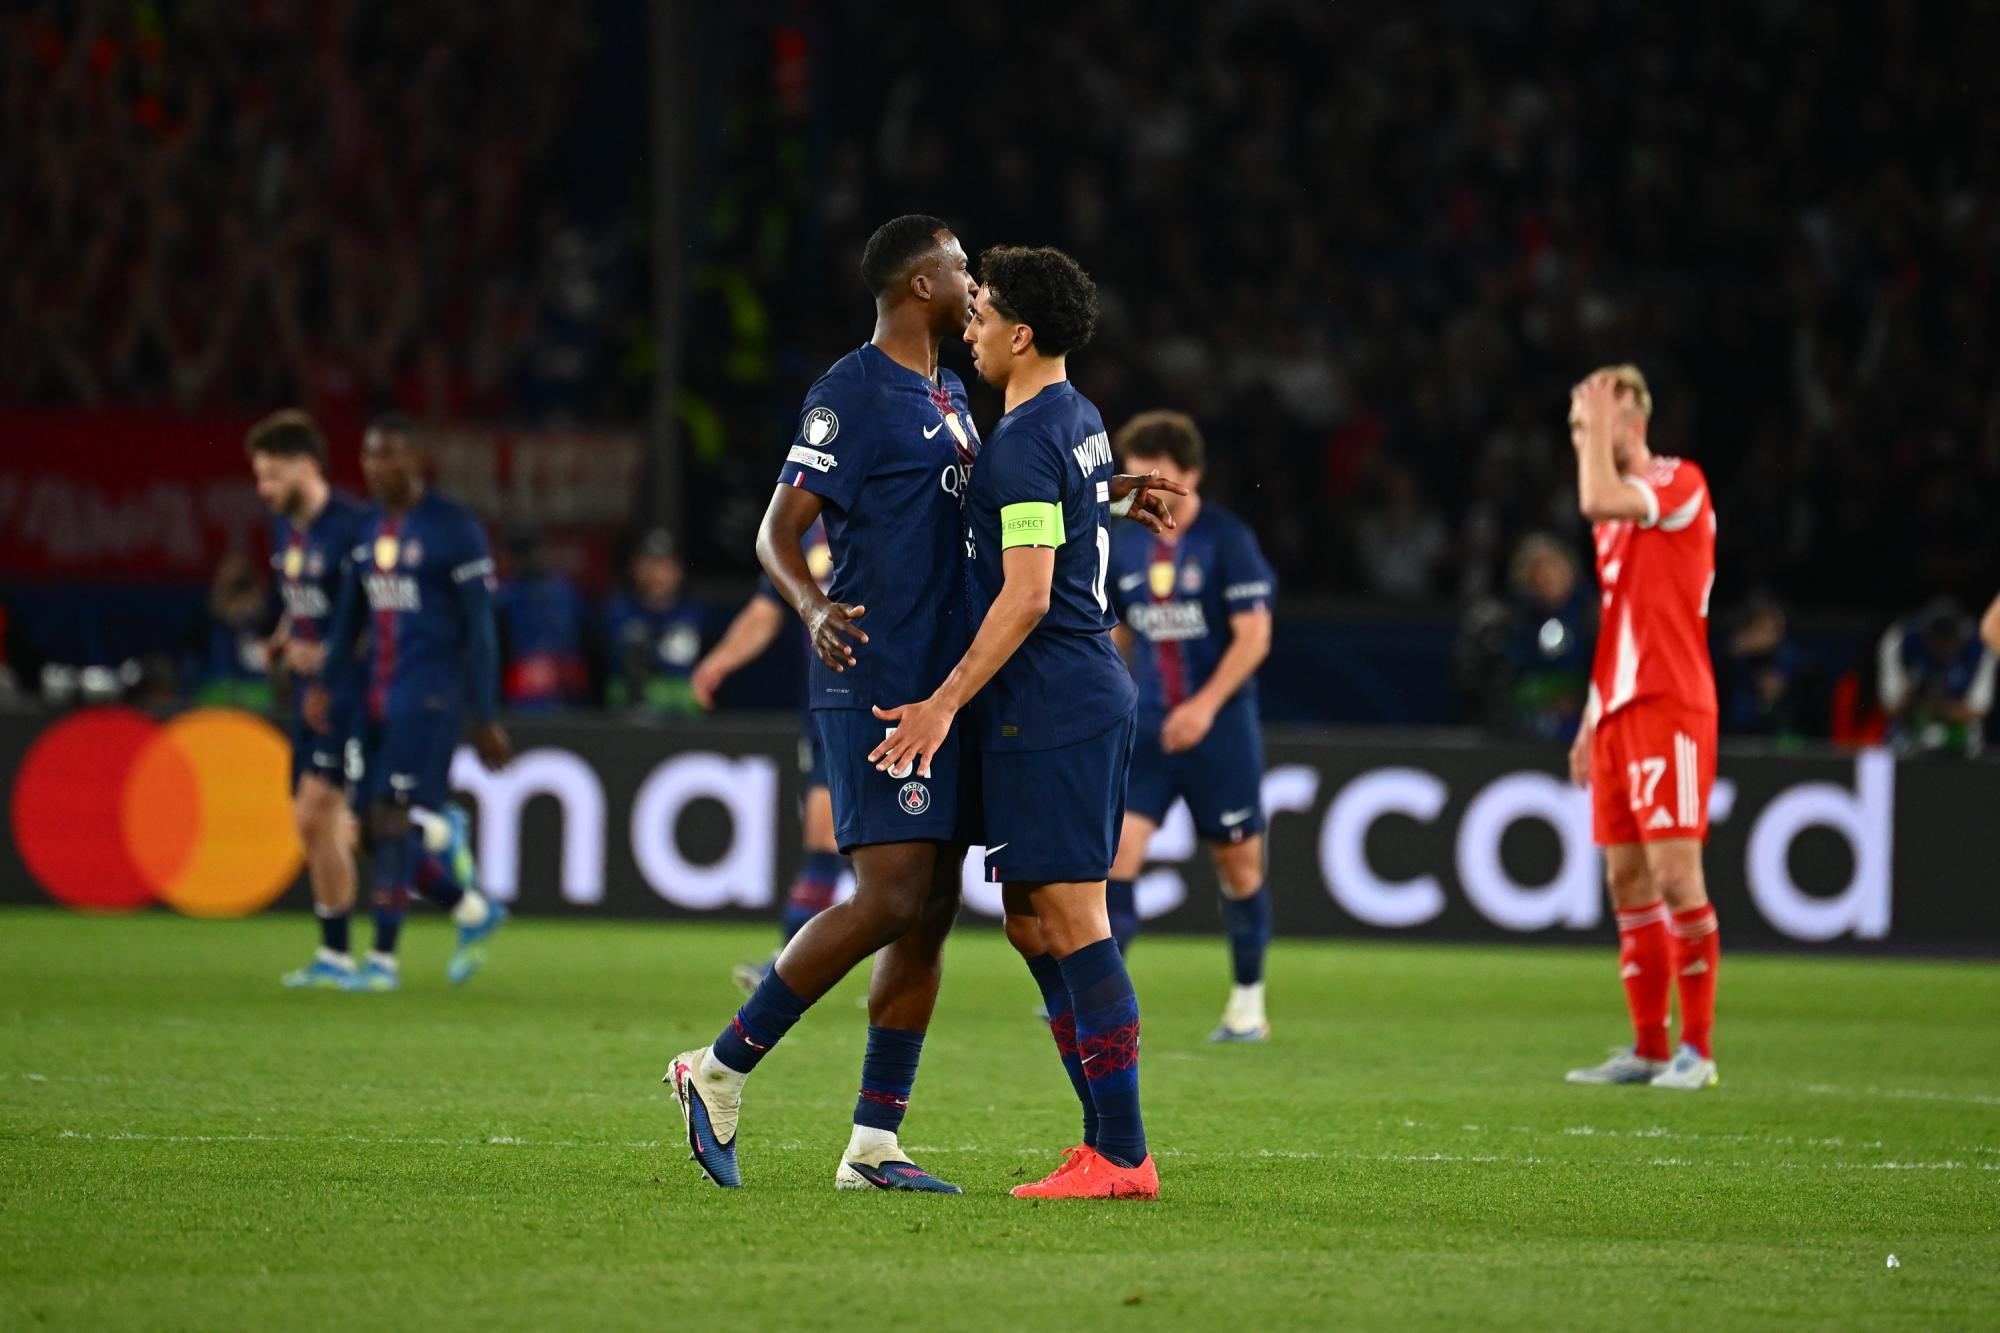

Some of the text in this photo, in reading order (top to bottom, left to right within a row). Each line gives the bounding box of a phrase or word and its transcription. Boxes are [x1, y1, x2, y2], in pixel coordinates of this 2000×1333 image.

[940, 464, 974, 498] QAT
[1007, 519, 1044, 531] RESPECT
[448, 745, 1895, 942] maecad
